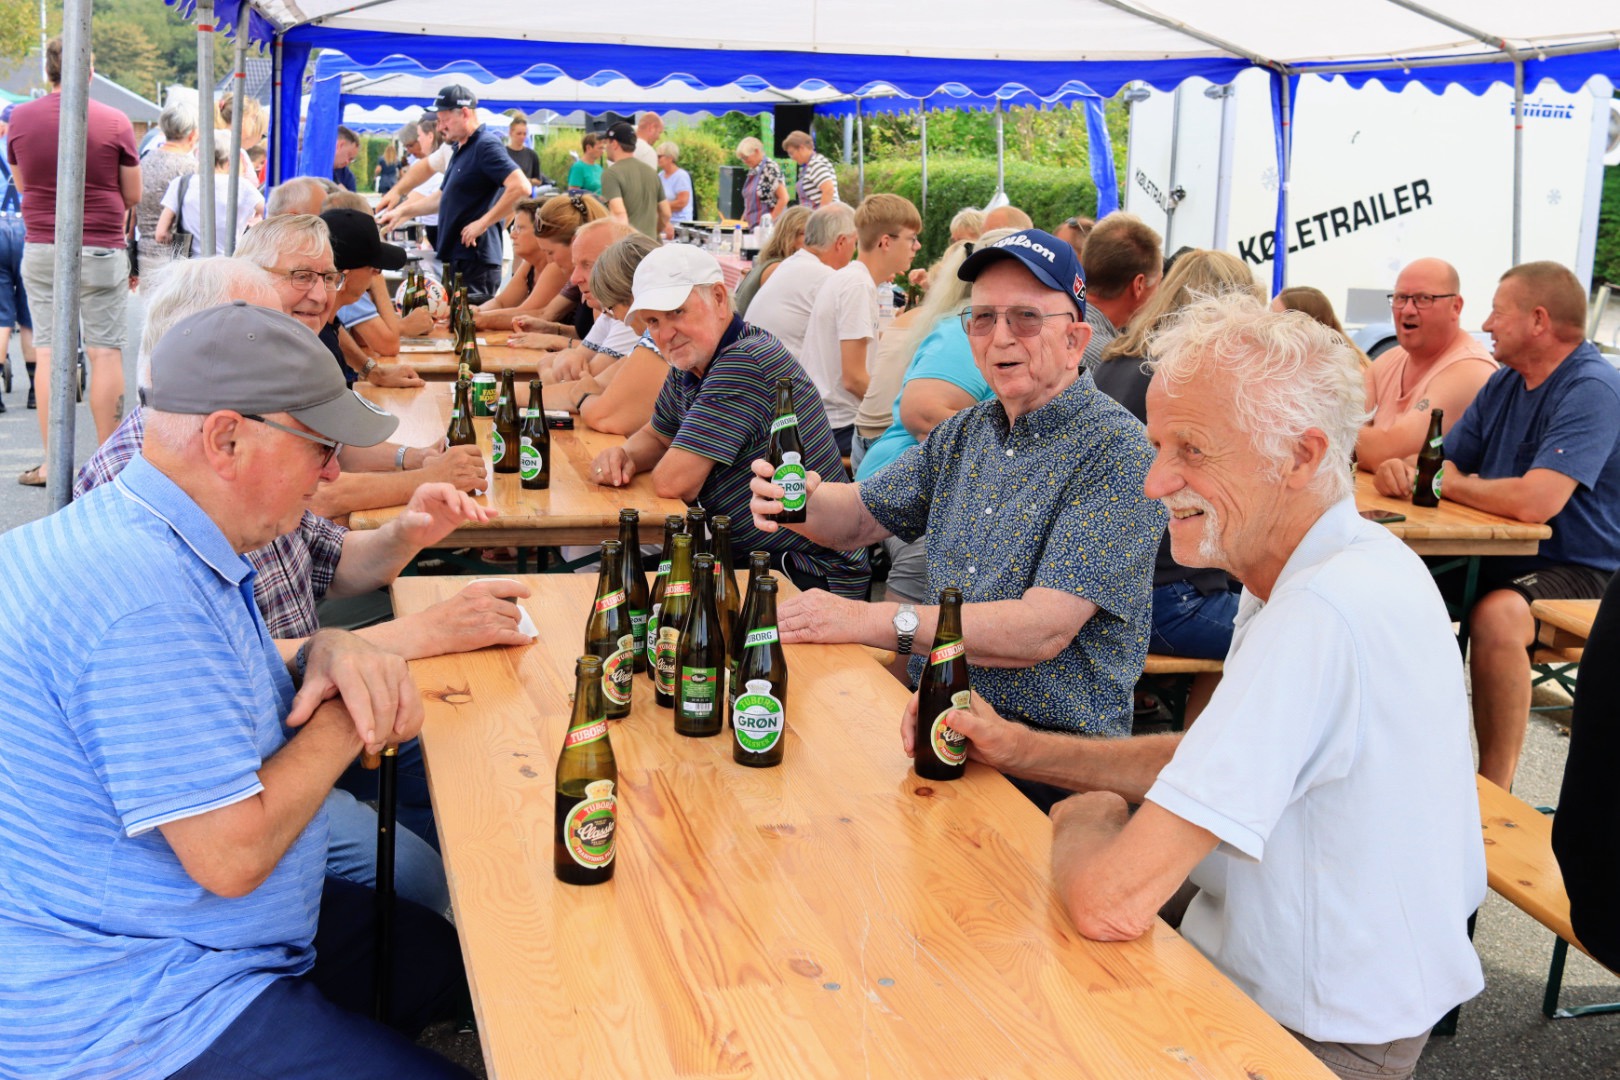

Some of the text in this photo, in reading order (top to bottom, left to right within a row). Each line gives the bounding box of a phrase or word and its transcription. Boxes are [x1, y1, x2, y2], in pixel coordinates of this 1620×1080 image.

[773, 417, 796, 429] TUBORG
[658, 564, 671, 573] BOR
[664, 585, 684, 594] BORG
[746, 631, 773, 643] UBORG
[740, 696, 776, 712] TUBORG
[737, 715, 778, 729] GRØN
[571, 721, 607, 744] TUBORG
[584, 801, 613, 814] TUBORG
